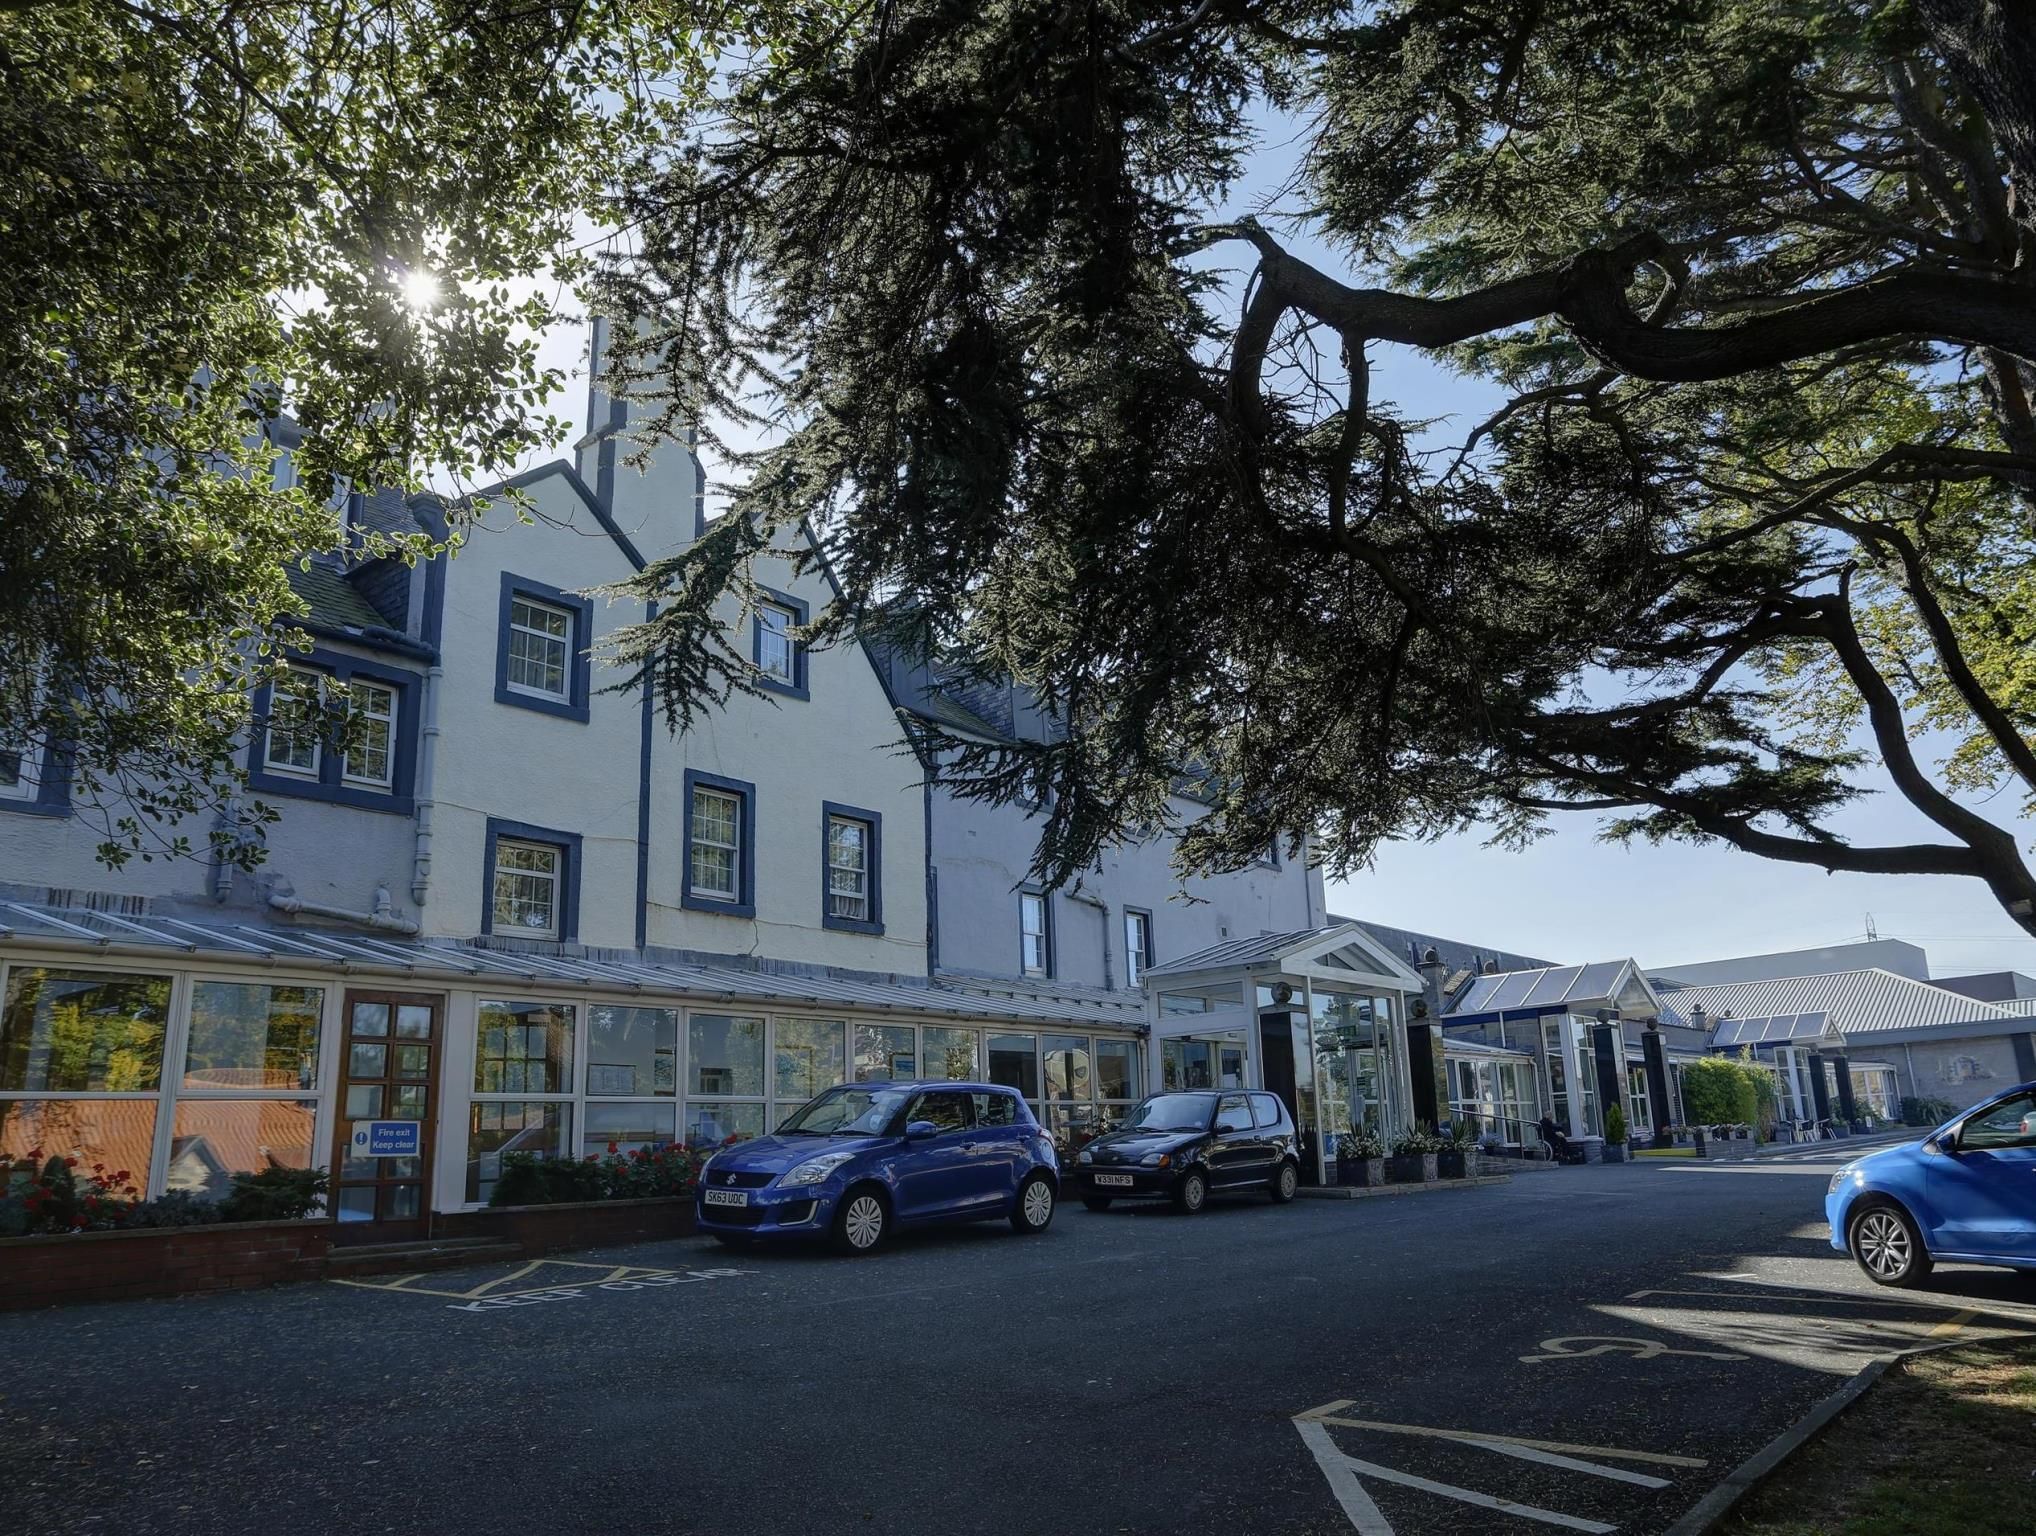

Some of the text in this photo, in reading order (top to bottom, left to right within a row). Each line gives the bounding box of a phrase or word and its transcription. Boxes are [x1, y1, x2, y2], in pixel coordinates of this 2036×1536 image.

[378, 1128, 410, 1137] Fire exit
[372, 1140, 415, 1150] Keep clear
[708, 1191, 727, 1204] SK63
[446, 1267, 761, 1312] KEEP CLEAR
